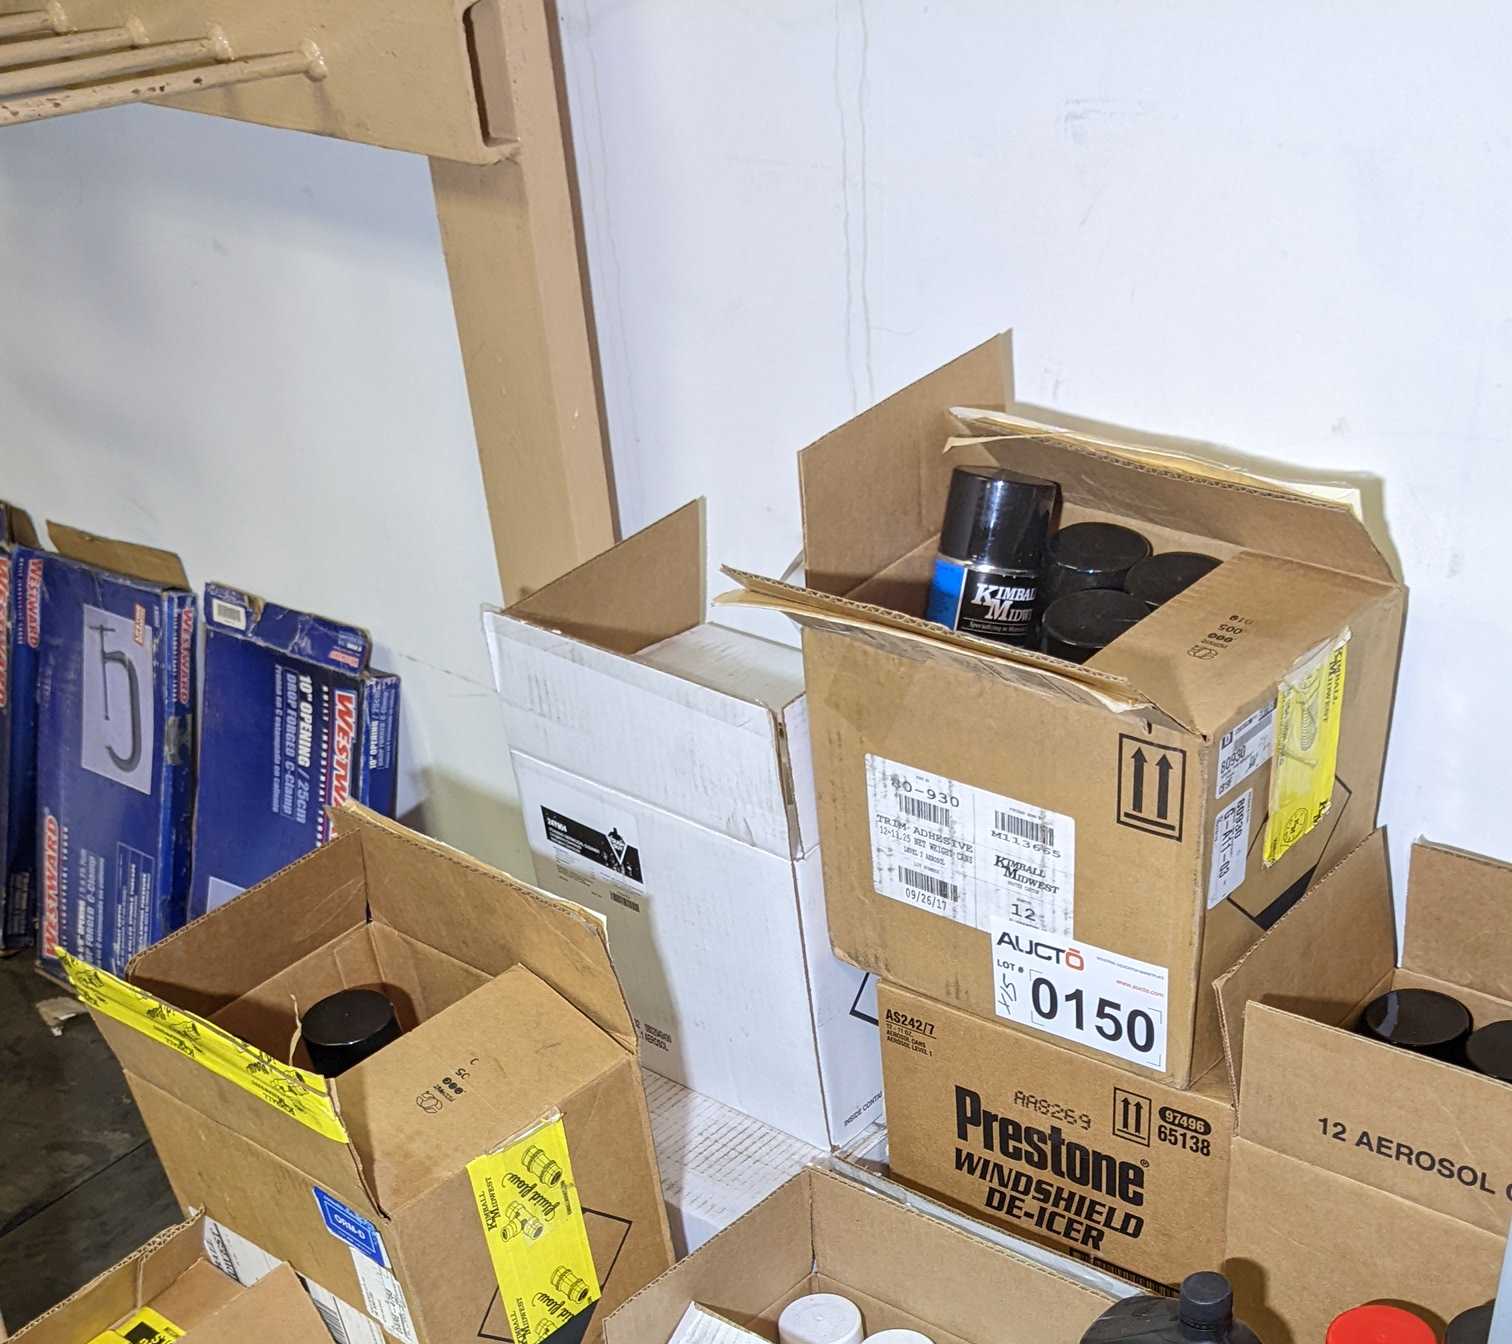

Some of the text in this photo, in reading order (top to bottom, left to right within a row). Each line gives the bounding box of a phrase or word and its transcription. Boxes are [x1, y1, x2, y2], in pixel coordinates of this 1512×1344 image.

[28, 560, 43, 647] WESTWARD
[971, 583, 1037, 607] KIMBAL
[984, 598, 1033, 622] MIDW
[179, 608, 193, 704] WESTWARD
[299, 674, 313, 700] 10"
[283, 673, 297, 815] DROP FORGED C-Clamp
[298, 701, 313, 768] OPENING
[331, 691, 357, 838] WESTWA
[296, 779, 310, 824] 25cm
[876, 813, 975, 853] TRIM ADHESIVE
[991, 830, 1062, 858] M113665
[44, 817, 60, 957] WESTWARD
[993, 854, 1047, 879] KIMBALL
[1003, 866, 1060, 894] MIDWEST
[905, 887, 948, 911] 09/26/17
[1011, 903, 1037, 922] 12
[997, 958, 1016, 971] LOT
[885, 1008, 936, 1036] AS242/7
[1031, 976, 1155, 1053] 0150
[1157, 1126, 1211, 1157] 65138
[1163, 1108, 1206, 1134] 97496
[954, 1084, 1145, 1208] Prestone
[1317, 1116, 1497, 1195] 12 AEROSOL
[478, 1190, 496, 1233] KIMBALL
[485, 1177, 502, 1219] MIDWEST
[954, 1146, 1145, 1240] WINDSHIELD
[333, 1213, 367, 1240] ORM-D
[984, 1187, 1105, 1251] DE-ICER
[516, 1296, 532, 1337] MIDWEST
